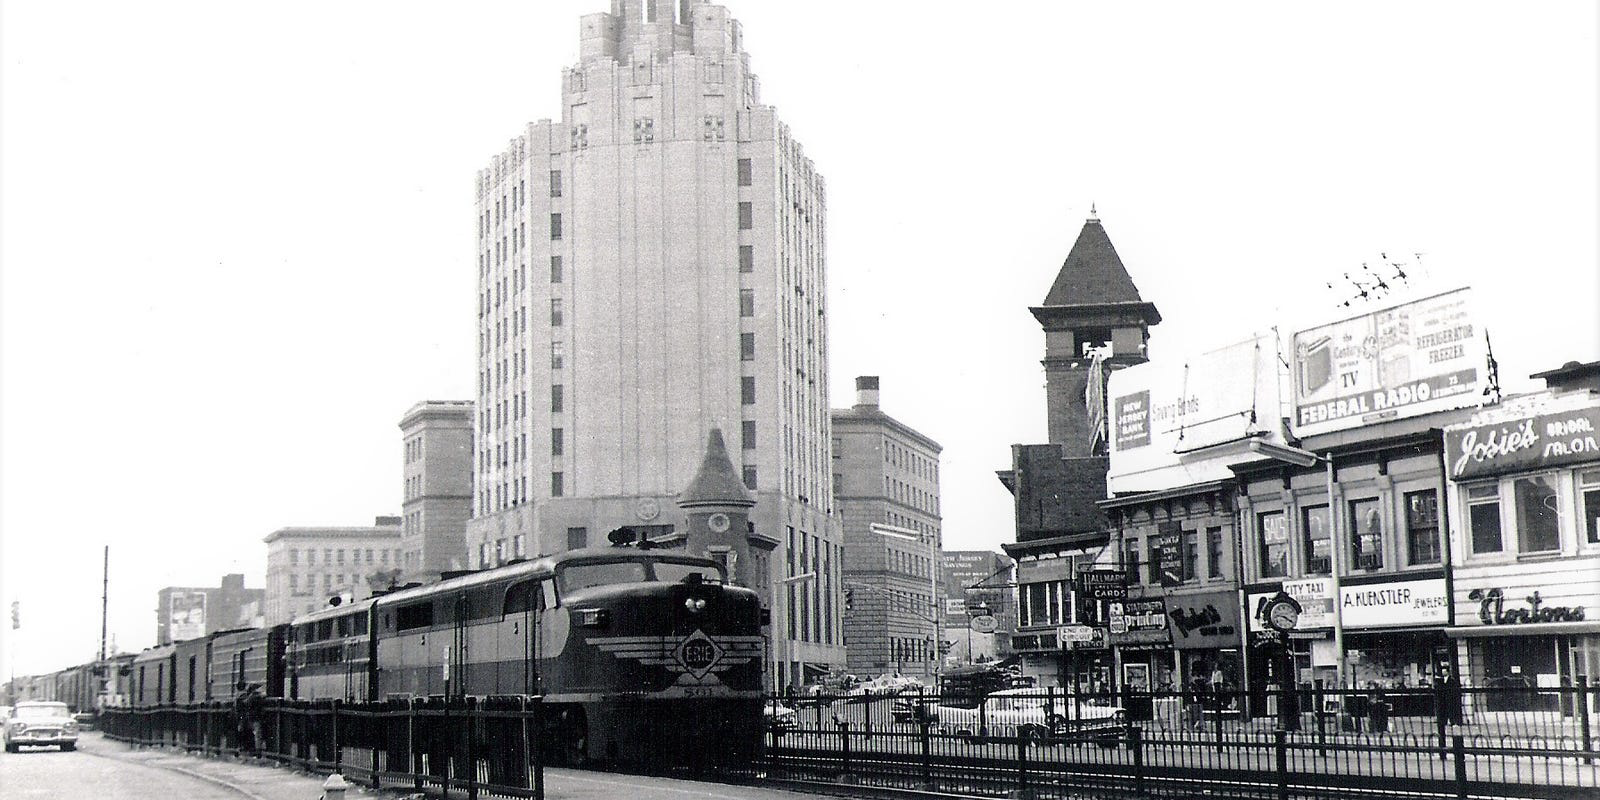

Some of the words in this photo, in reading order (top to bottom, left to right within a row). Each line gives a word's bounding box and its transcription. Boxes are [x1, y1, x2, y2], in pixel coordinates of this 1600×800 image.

[1416, 324, 1474, 350] REFRIGERATOR
[1429, 344, 1464, 364] FREEZER
[1341, 370, 1359, 388] TV
[1122, 401, 1142, 413] NEW
[1301, 396, 1370, 425] FEDERAL
[1374, 382, 1432, 410] RADIO
[1118, 410, 1148, 426] JERSEY
[1122, 423, 1145, 436] BANK
[1546, 417, 1595, 437] BRIDAL
[1454, 418, 1540, 476] Josie's
[1543, 436, 1599, 457] SALON
[1285, 584, 1304, 596] CITY
[1306, 583, 1324, 594] TAXI
[1126, 601, 1163, 612] STATIONERY
[1413, 597, 1449, 609] JEWELERS
[686, 645, 712, 662] ERIE
